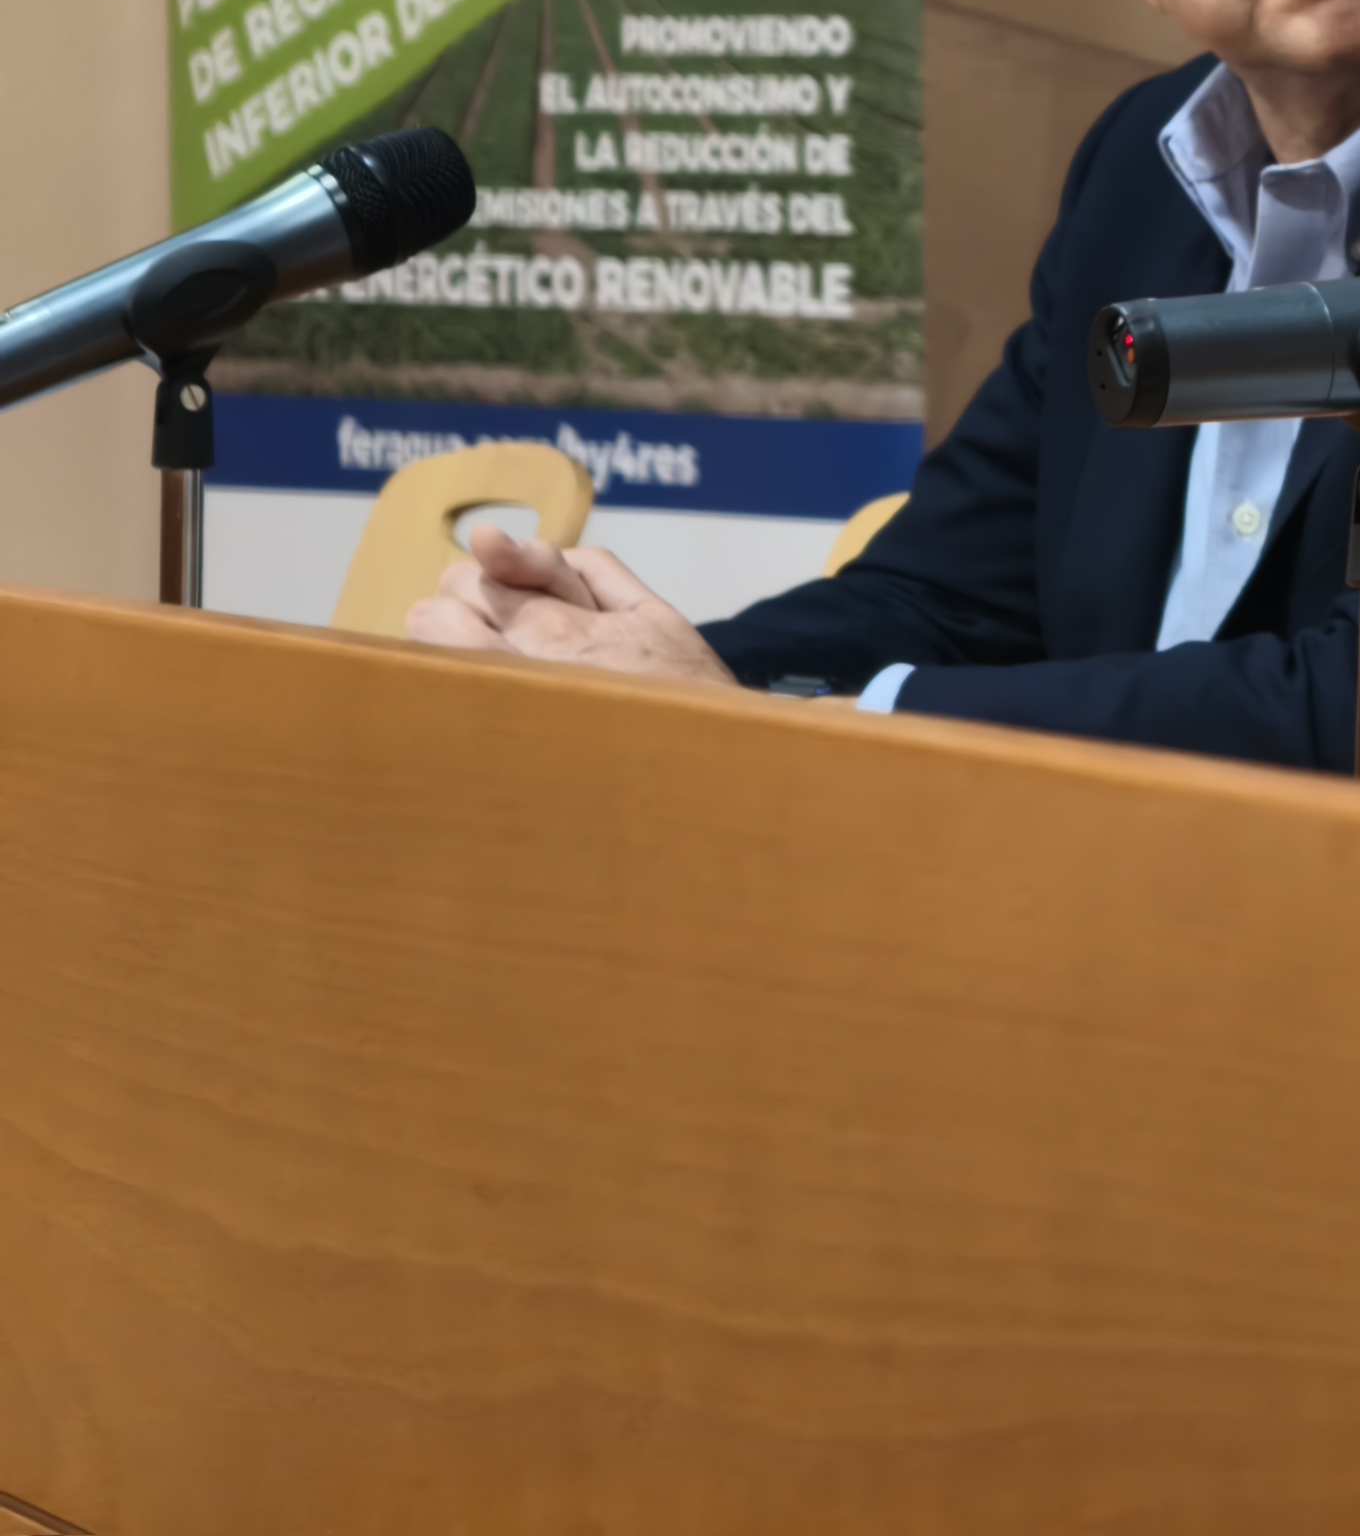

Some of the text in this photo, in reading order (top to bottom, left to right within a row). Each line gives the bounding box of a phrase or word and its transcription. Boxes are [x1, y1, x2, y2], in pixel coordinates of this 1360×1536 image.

[621, 15, 852, 56] PROMOVIENDO
[189, 26, 242, 103] DE
[204, 11, 394, 181] INFERIOR
[539, 73, 853, 114] EL AUTOCONSUMO Y
[575, 123, 853, 176] LA REDUCCIÓN DE
[637, 191, 660, 231] A
[667, 181, 783, 235] TRAVÉS
[788, 192, 854, 236] DEL
[596, 256, 853, 318] RENOVABLE
